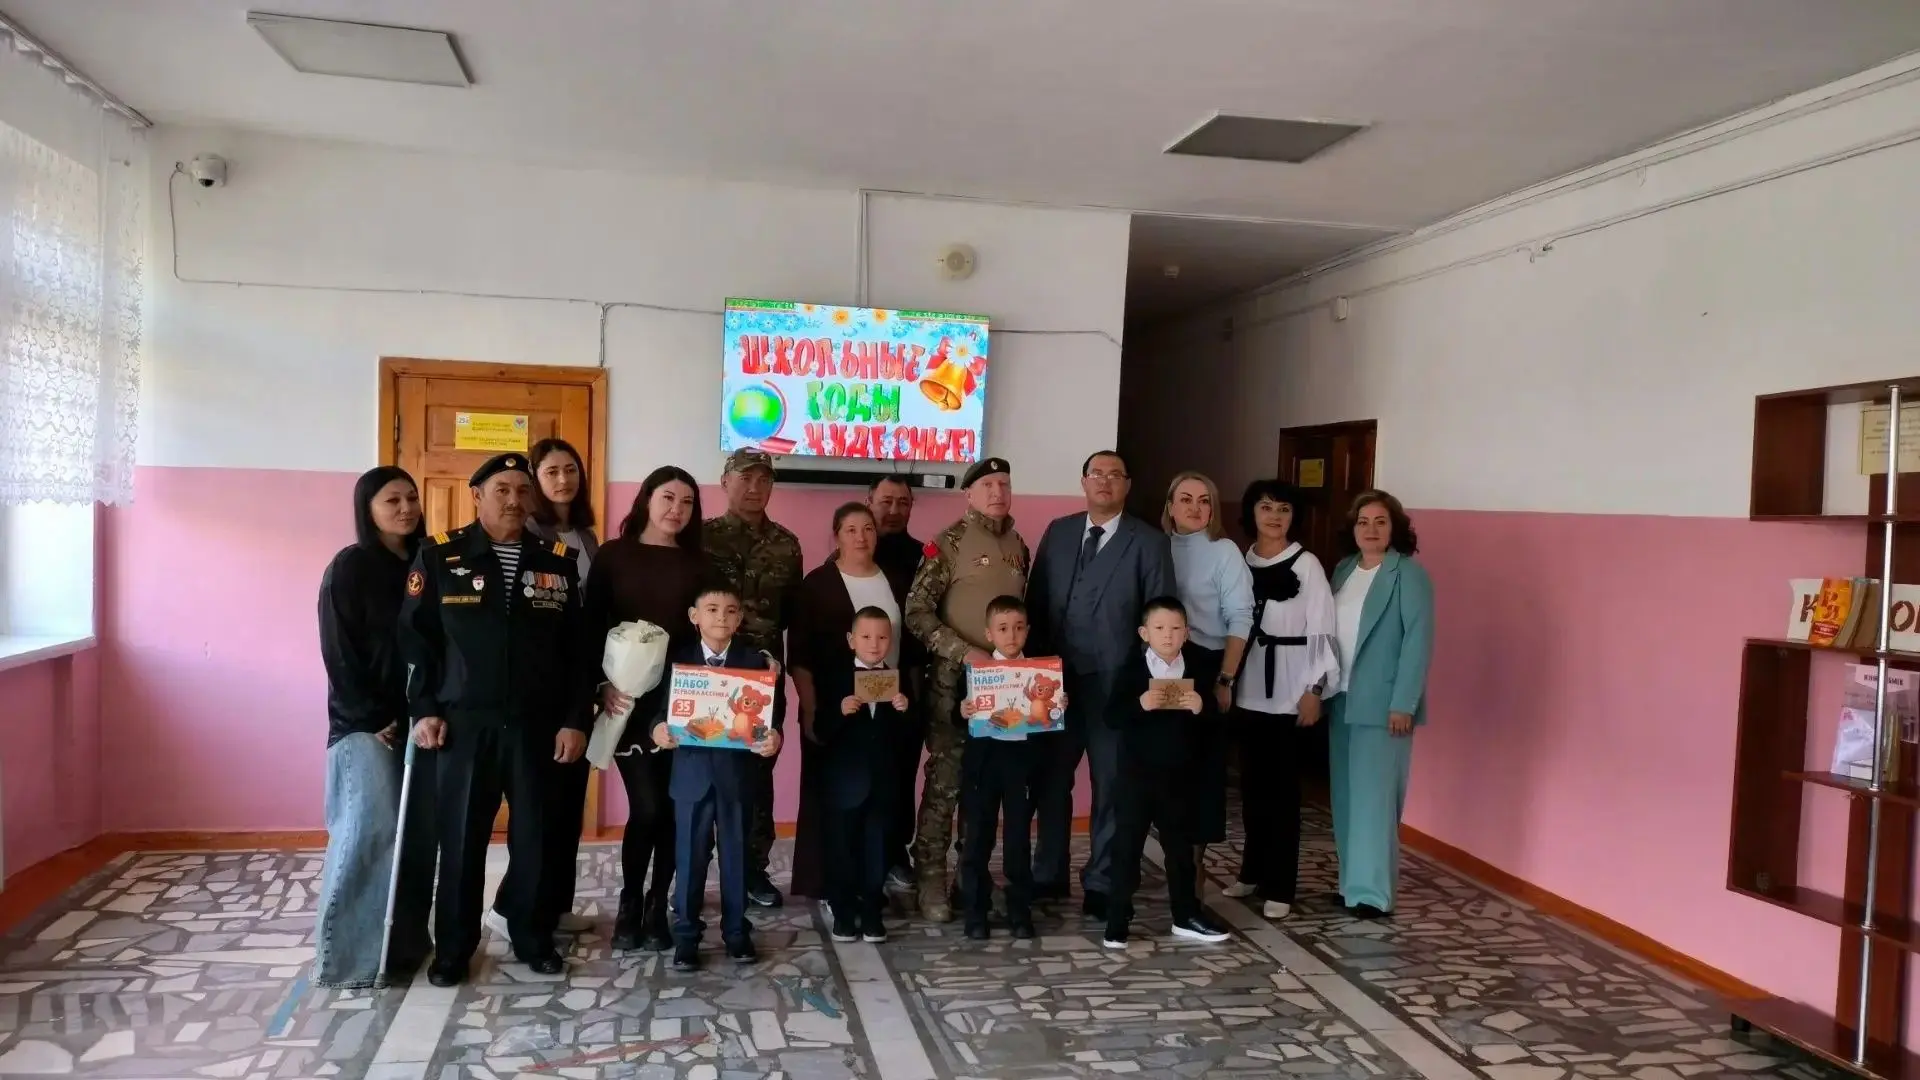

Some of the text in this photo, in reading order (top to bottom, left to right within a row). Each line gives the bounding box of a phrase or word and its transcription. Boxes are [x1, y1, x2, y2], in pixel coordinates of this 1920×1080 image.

[740, 335, 925, 383] ШКОЛЬНЫЕ
[806, 380, 900, 423] ГОДЫ
[804, 423, 975, 463] ЧУДЕСНЫЕ!
[674, 678, 709, 689] НАБОР
[974, 675, 1005, 685] НАБОР
[676, 700, 691, 712] 35
[979, 696, 992, 705] 35
